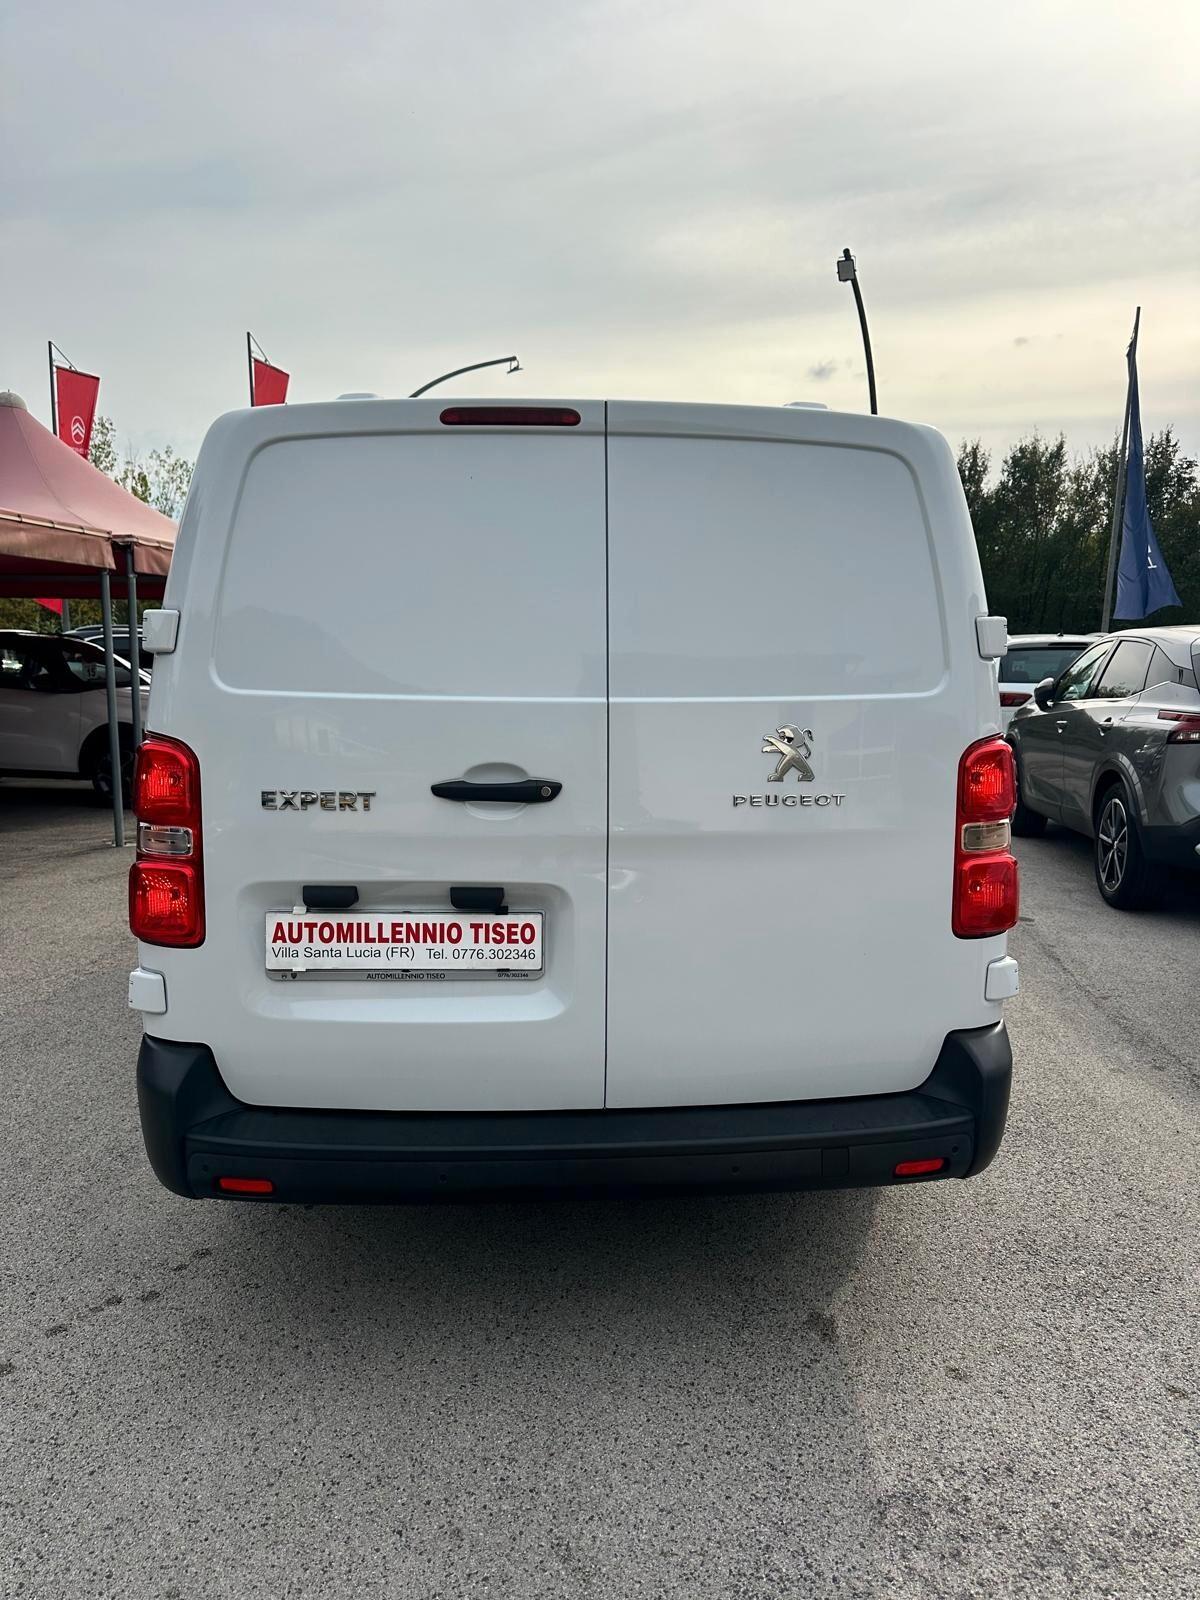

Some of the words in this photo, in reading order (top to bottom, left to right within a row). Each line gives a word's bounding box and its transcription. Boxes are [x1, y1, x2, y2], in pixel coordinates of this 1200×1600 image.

[261, 791, 377, 811] EXPERT
[732, 794, 847, 807] PEUGEOT
[271, 921, 463, 944] AUTOMILLENNIO
[469, 922, 536, 945] TISEO
[271, 946, 299, 958] Villa
[303, 946, 342, 958] Santa
[346, 946, 381, 958] Lucia
[385, 946, 415, 961] (FR)
[425, 948, 448, 960] Tel.
[452, 948, 536, 960] 0776.302346
[366, 972, 425, 980] AUTOMILLENNIO
[426, 972, 446, 980] TISEO
